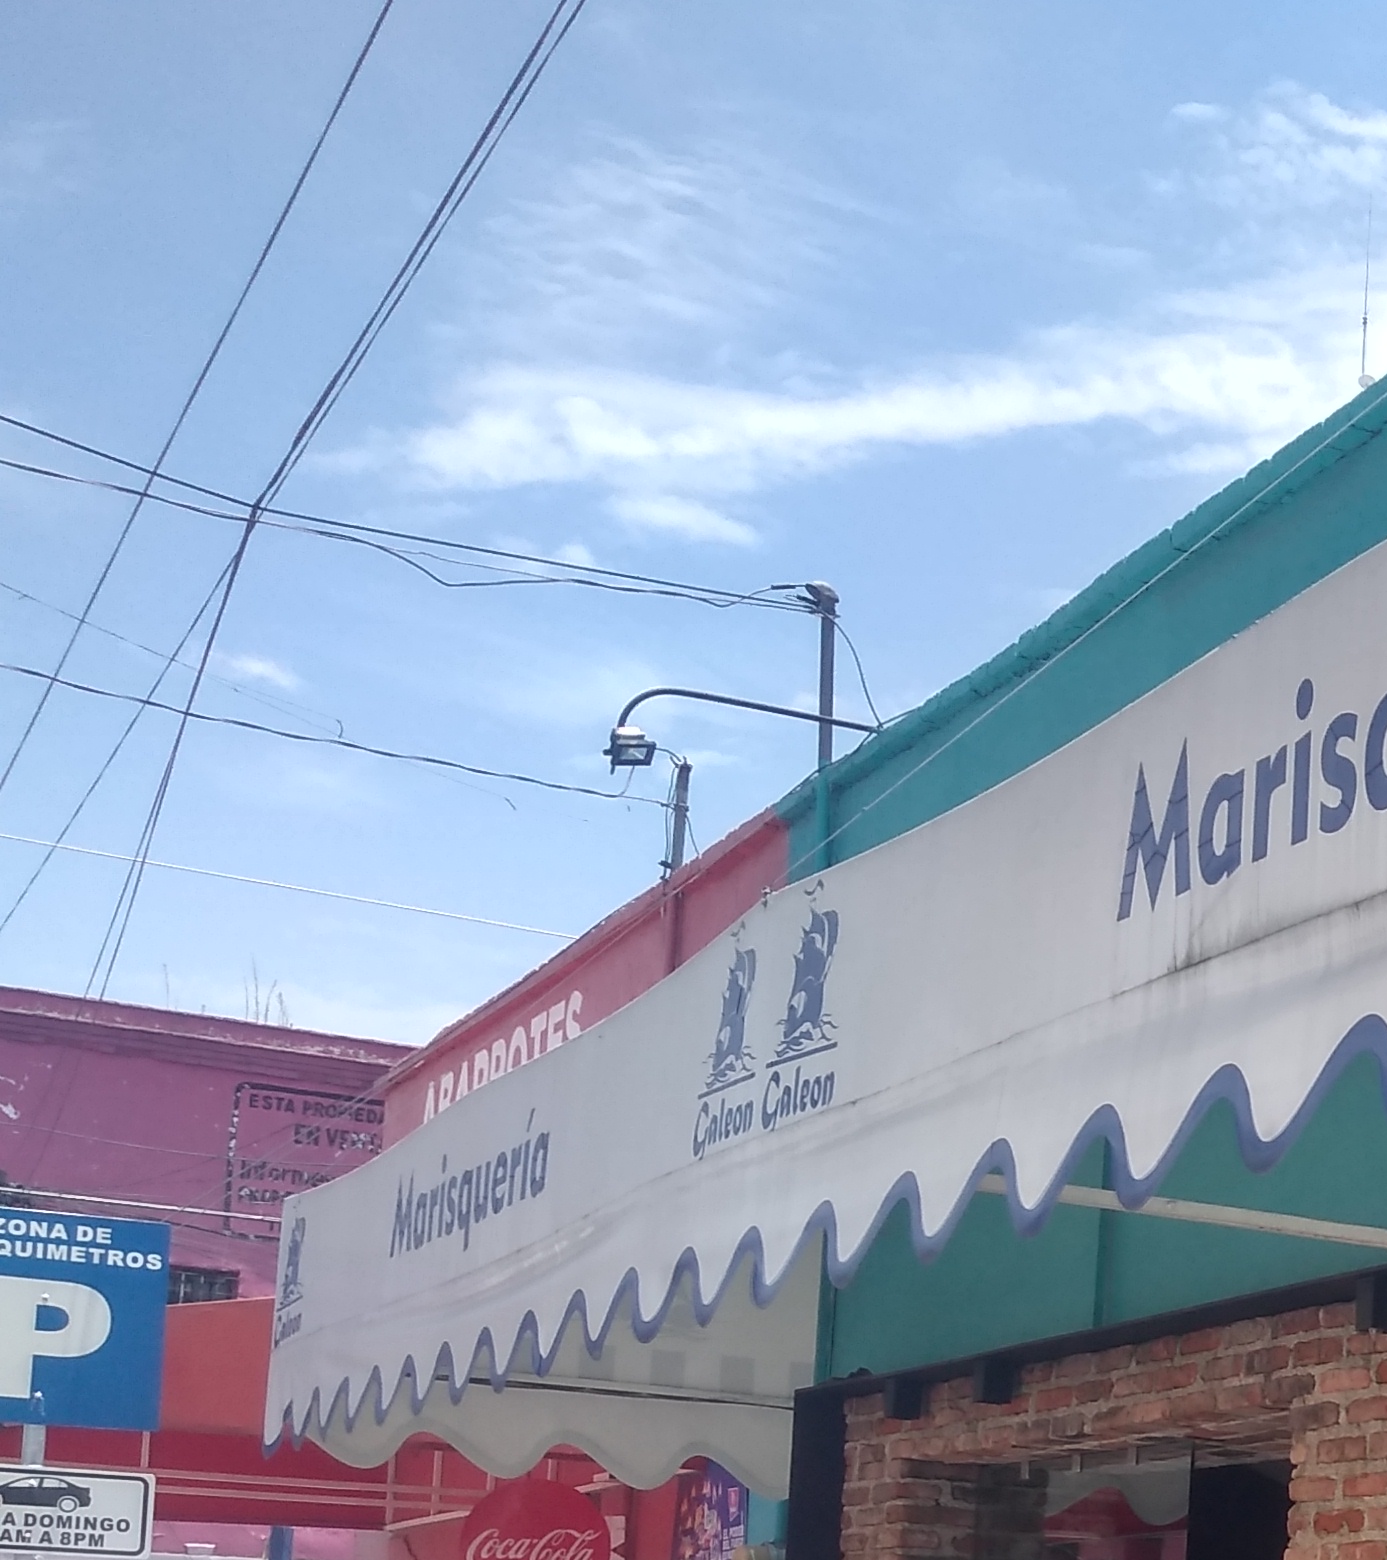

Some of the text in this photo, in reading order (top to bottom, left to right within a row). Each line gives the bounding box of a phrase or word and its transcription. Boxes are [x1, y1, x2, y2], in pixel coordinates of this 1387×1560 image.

[248, 1094, 295, 1113] ESTA
[693, 1065, 835, 1161] Galeon Galeon
[389, 1107, 550, 1259] Marisquería
[76, 1225, 112, 1244] DE
[0, 1275, 113, 1400] P
[2, 1512, 131, 1533] A DOMINGO
[38, 1530, 53, 1545] A
[59, 1531, 105, 1548] 8PM
